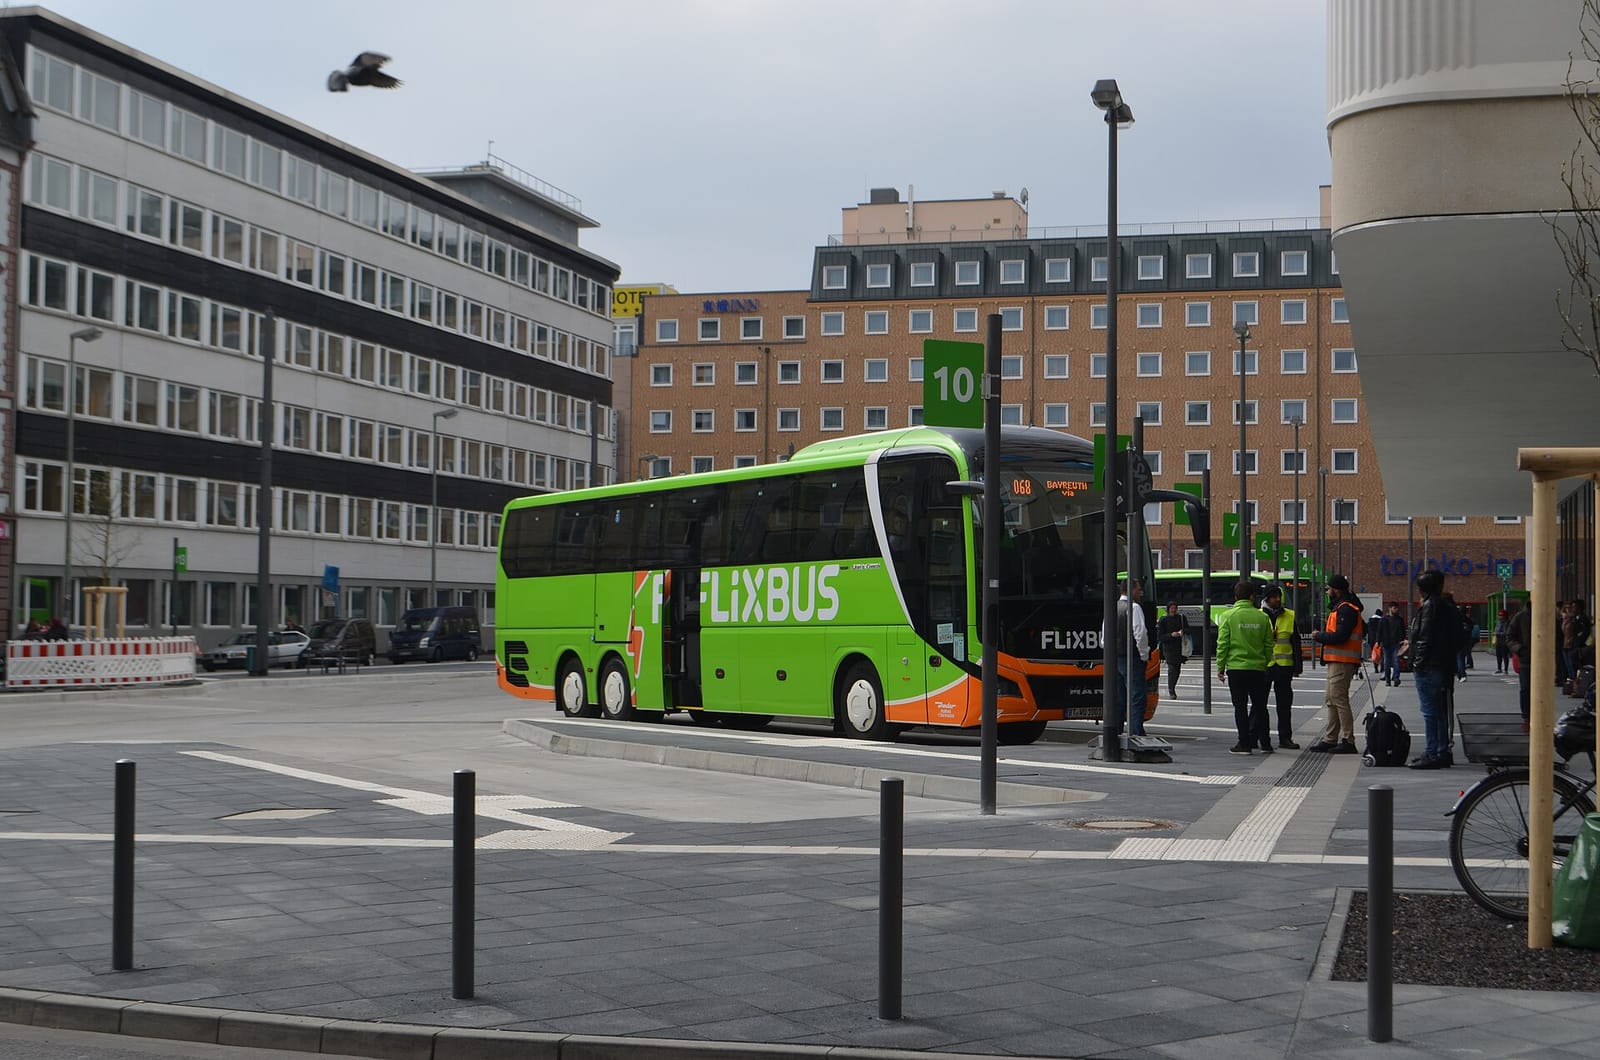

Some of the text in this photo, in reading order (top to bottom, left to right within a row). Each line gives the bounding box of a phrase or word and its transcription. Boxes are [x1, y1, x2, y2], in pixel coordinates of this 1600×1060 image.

[613, 291, 652, 304] OTE
[933, 366, 974, 403] 10
[1013, 479, 1032, 495] 068
[1046, 480, 1088, 490] BAYREUTH
[1230, 523, 1238, 537] 7
[1261, 540, 1268, 552] 6
[1283, 551, 1289, 562] 5
[1302, 563, 1308, 573] 4
[1041, 630, 1104, 649] FLiXB
